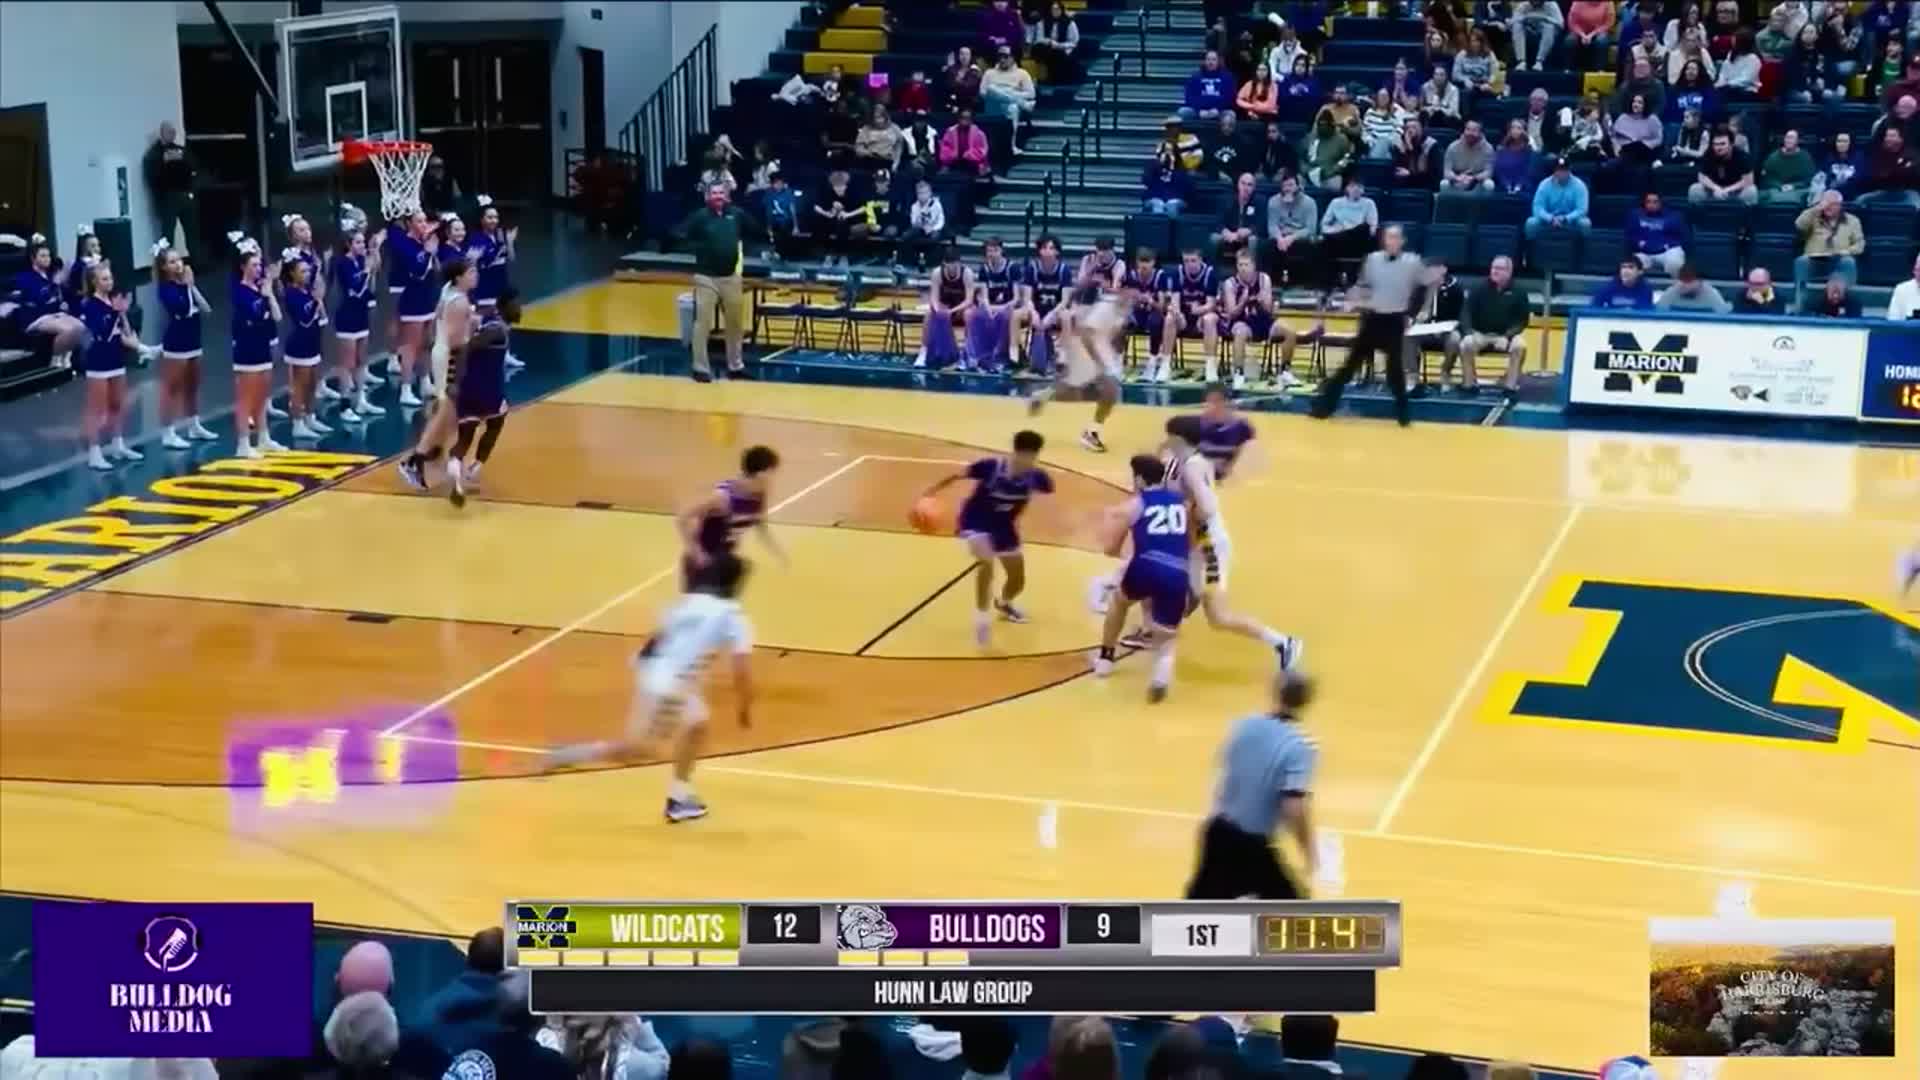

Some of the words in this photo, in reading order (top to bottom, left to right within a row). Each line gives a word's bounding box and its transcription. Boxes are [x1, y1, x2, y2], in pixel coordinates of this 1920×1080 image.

[1608, 353, 1684, 372] MARION
[0, 451, 379, 608] ARION
[1144, 504, 1187, 535] 20
